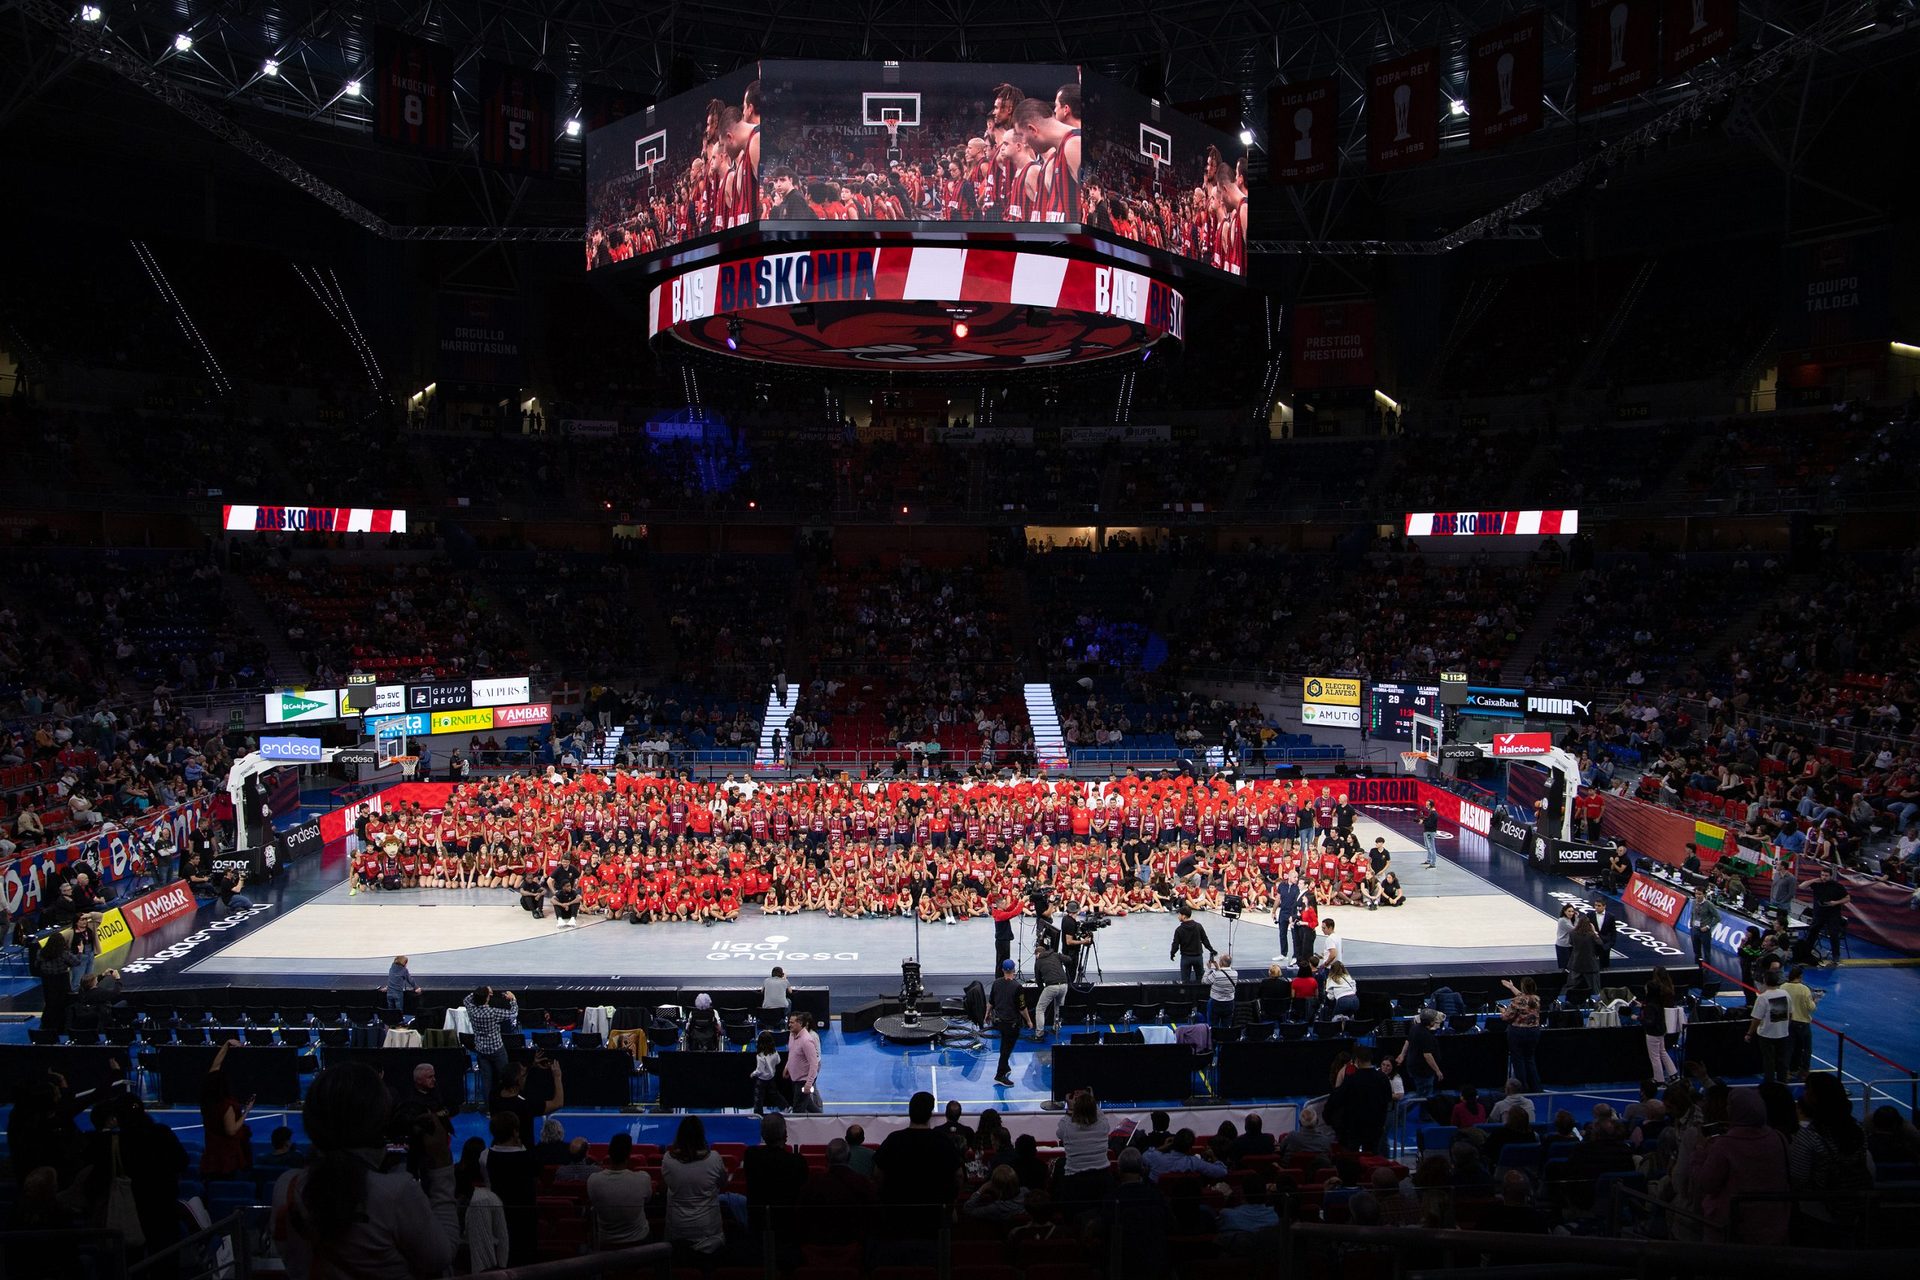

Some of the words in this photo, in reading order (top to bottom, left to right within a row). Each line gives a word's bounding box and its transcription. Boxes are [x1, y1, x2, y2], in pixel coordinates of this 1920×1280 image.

[404, 95, 423, 125] 8
[509, 121, 527, 150] 5
[721, 252, 876, 312] BASKONIA
[1807, 276, 1858, 297] EQUIPO
[672, 272, 704, 321] BAS
[1095, 266, 1137, 320] BAS
[1806, 293, 1860, 312] TALDEA
[455, 327, 505, 341] ORGULLO
[1306, 334, 1361, 349] PRESTIGIO
[440, 339, 519, 355] HARROTASUNA
[256, 508, 333, 529] BASKONIA
[1432, 514, 1502, 533] BASKONIA
[432, 685, 467, 695] GRUPO
[1325, 682, 1356, 691] ELECTRO
[1325, 689, 1357, 697] ALAVESA
[387, 691, 400, 699] SVC
[432, 695, 467, 705] REGUI
[1388, 695, 1400, 704] 29
[1414, 697, 1426, 706] 40
[1476, 696, 1519, 708] CaixaBank
[1527, 696, 1574, 715] PUMA
[432, 713, 491, 728] HORNIPLAS
[506, 706, 548, 721] AMBAR
[1318, 710, 1360, 722] AMUTIO
[261, 741, 320, 757] endesa
[1445, 749, 1475, 758] endesa
[1499, 744, 1529, 754] Halcón
[341, 754, 374, 764] endesa
[287, 823, 320, 848] endesa
[144, 888, 189, 921] AMBAR
[1637, 884, 1676, 915] AMBAR
[97, 920, 125, 942] RIDAD
[711, 940, 779, 953] liga
[706, 950, 860, 961] endesa
